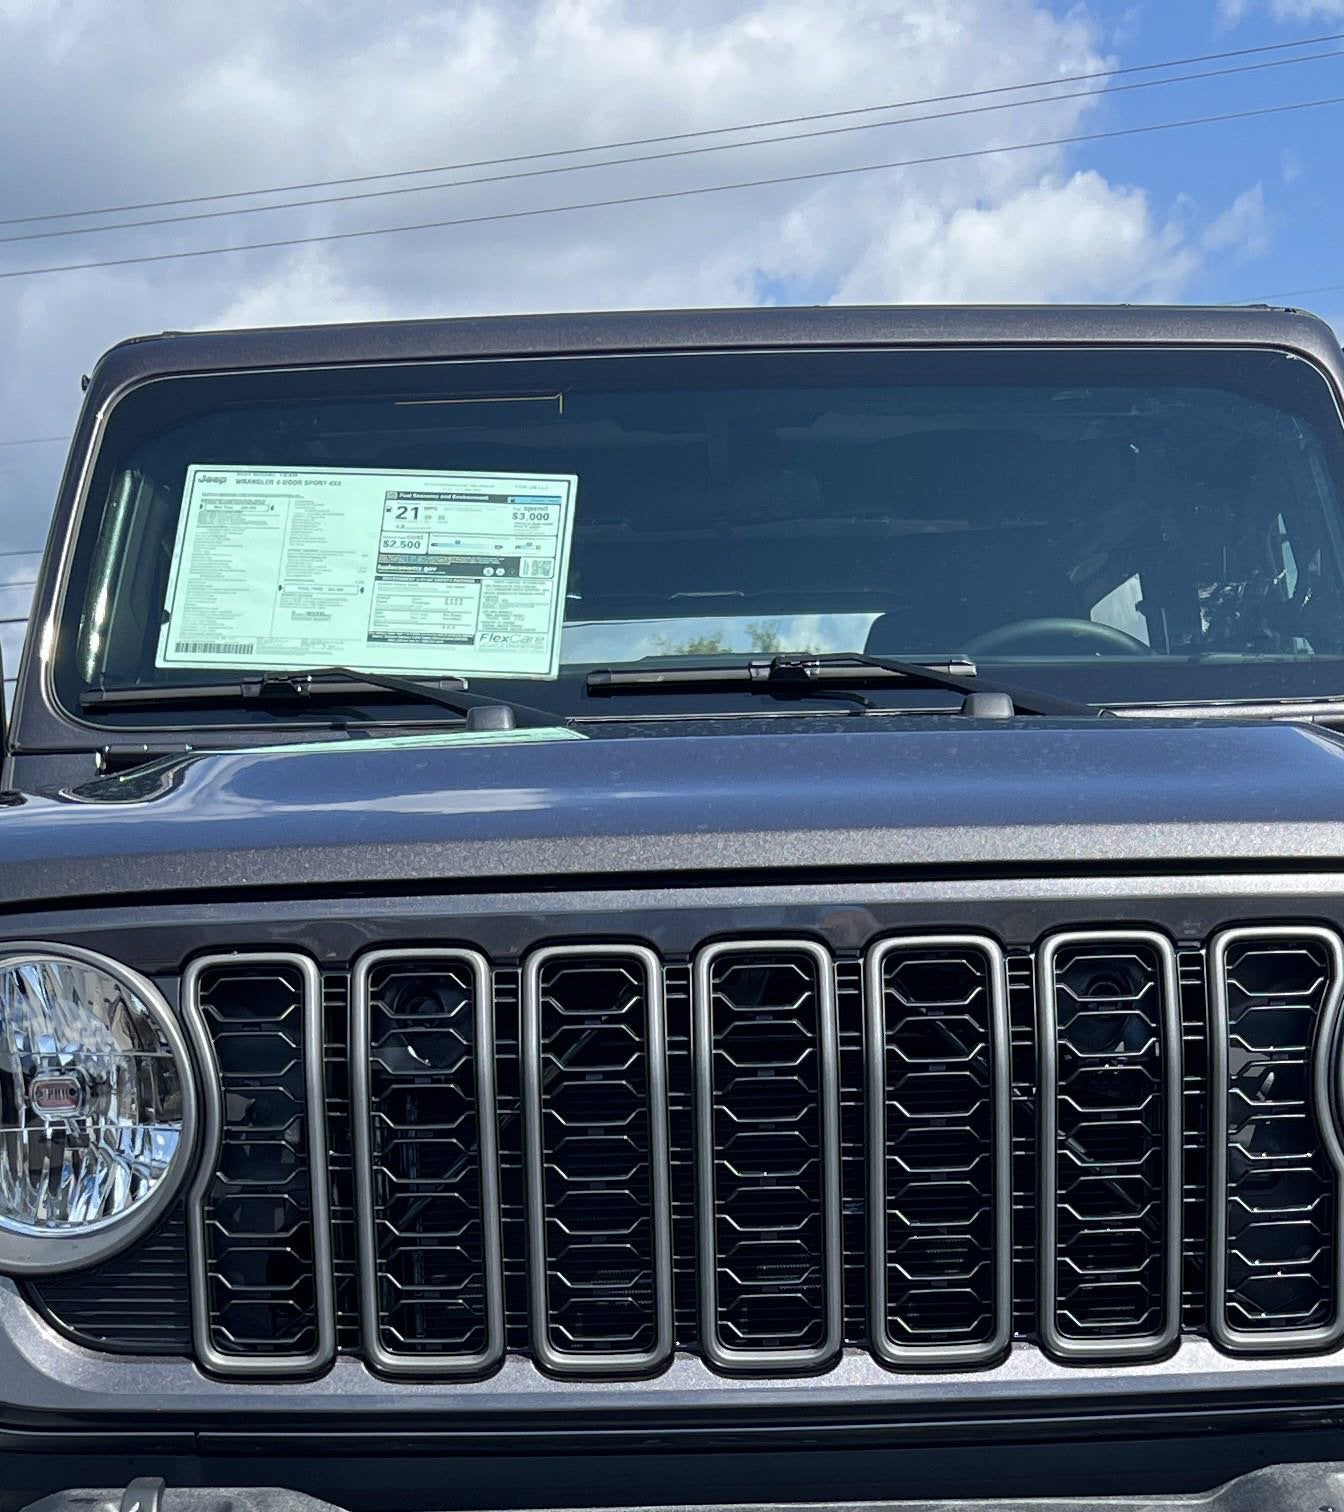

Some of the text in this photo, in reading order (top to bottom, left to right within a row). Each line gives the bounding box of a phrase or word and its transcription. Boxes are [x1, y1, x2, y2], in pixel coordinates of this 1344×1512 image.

[198, 474, 227, 485] Jeep
[304, 479, 327, 487] SPORT
[395, 506, 419, 521] 21
[512, 512, 550, 521] $3,000
[383, 539, 421, 549] $2,500
[479, 633, 545, 644] FlexCare
